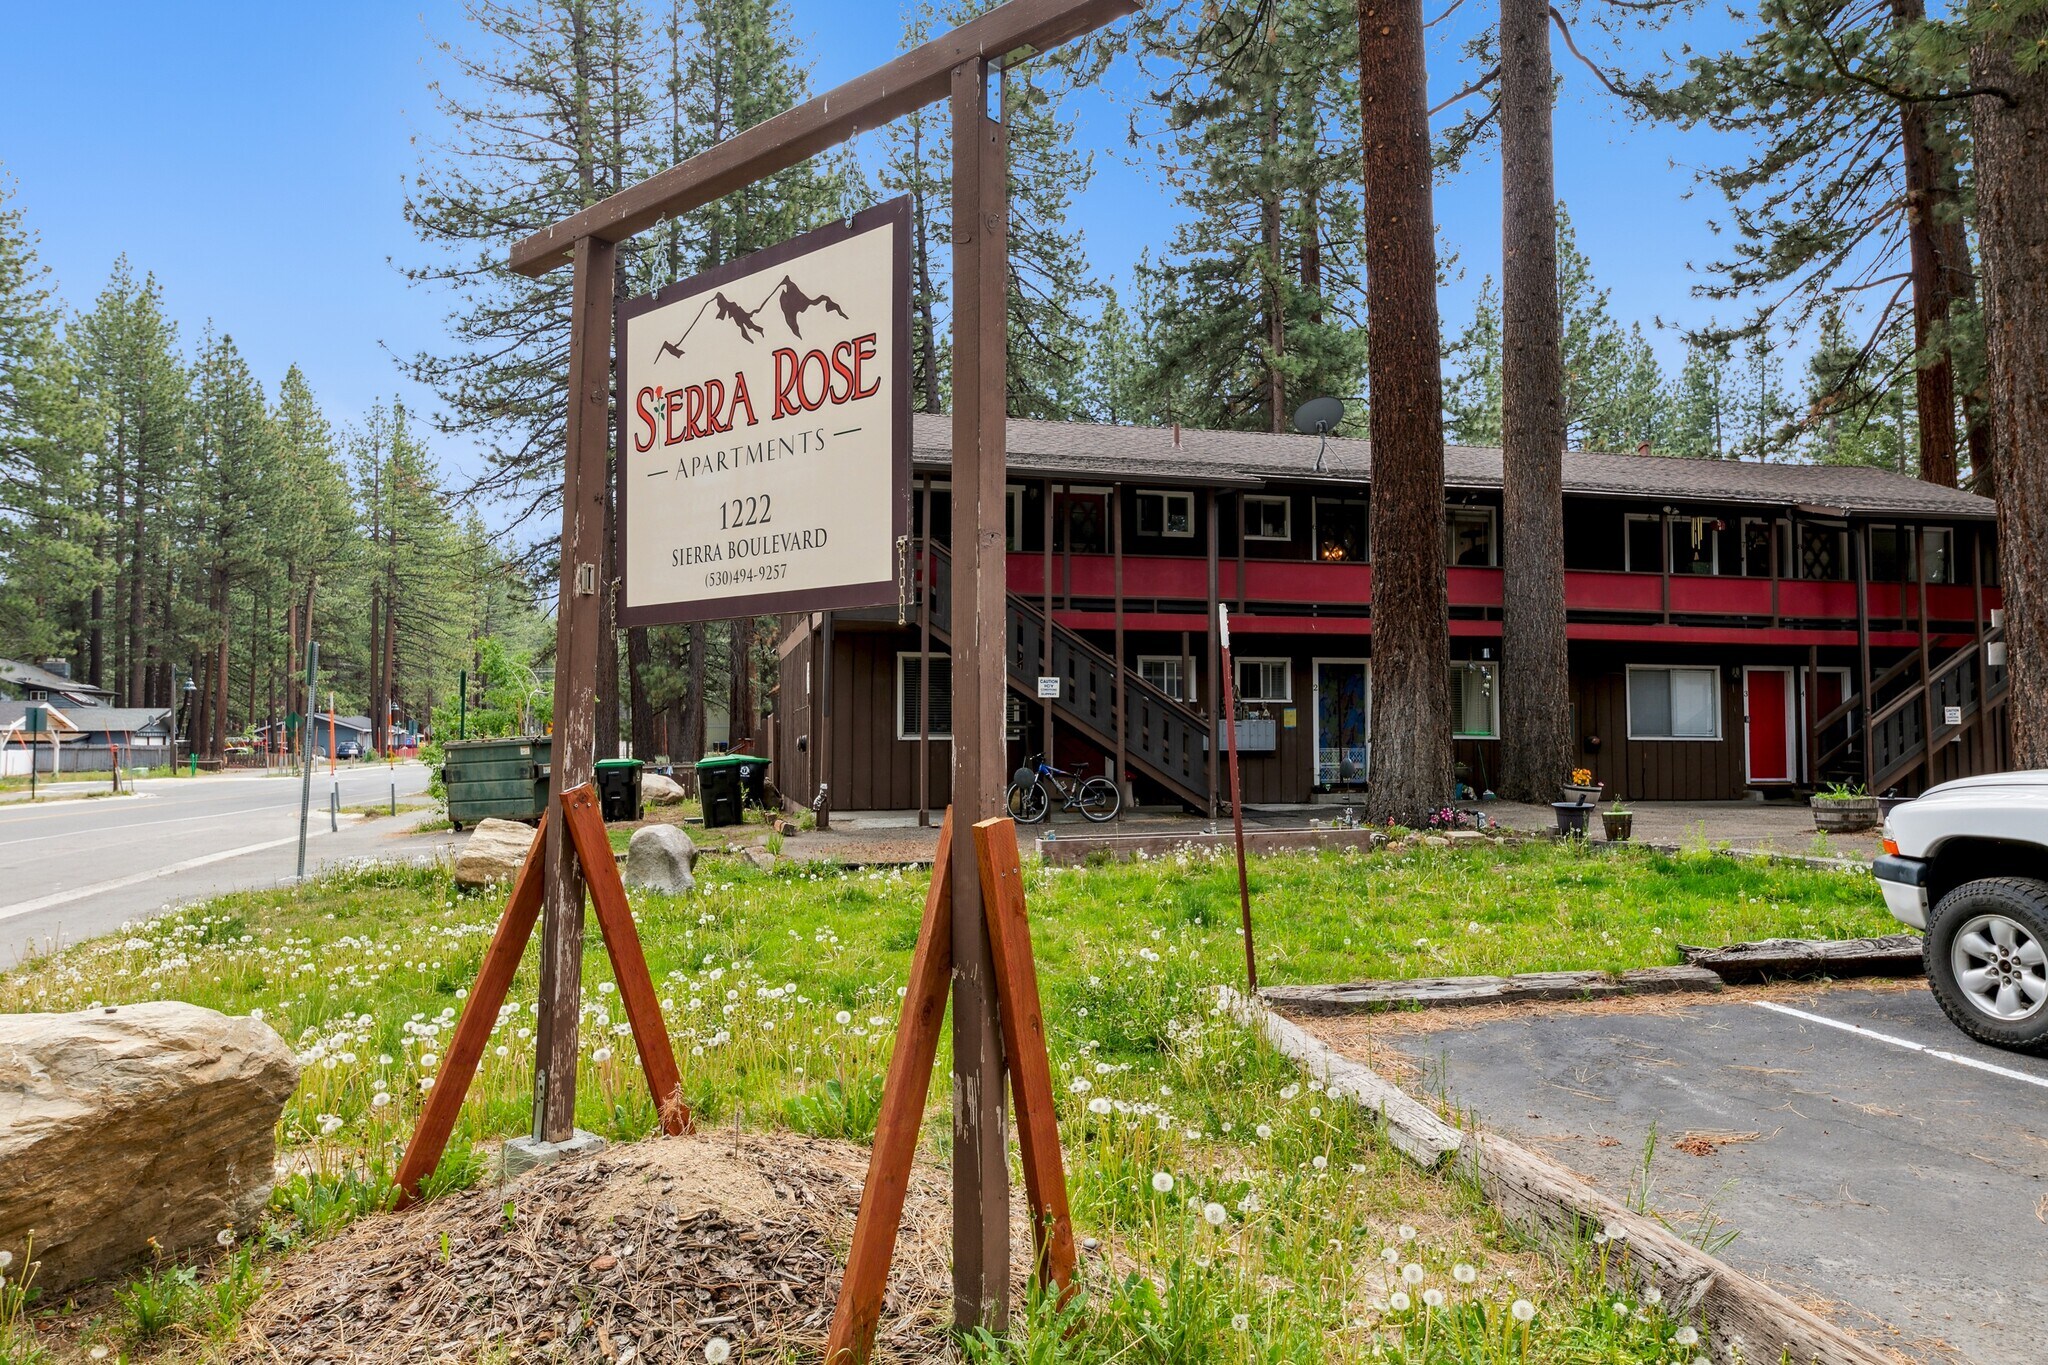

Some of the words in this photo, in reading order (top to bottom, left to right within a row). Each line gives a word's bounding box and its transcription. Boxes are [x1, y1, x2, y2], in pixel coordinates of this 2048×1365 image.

[771, 332, 882, 421] ROSE
[675, 428, 825, 481] APARTMENTS
[719, 493, 772, 530] 1222
[671, 543, 723, 567] SIERRA
[728, 527, 828, 559] BOULEVARD
[704, 563, 788, 589] (530)494-9257
[1313, 683, 1319, 691] 2
